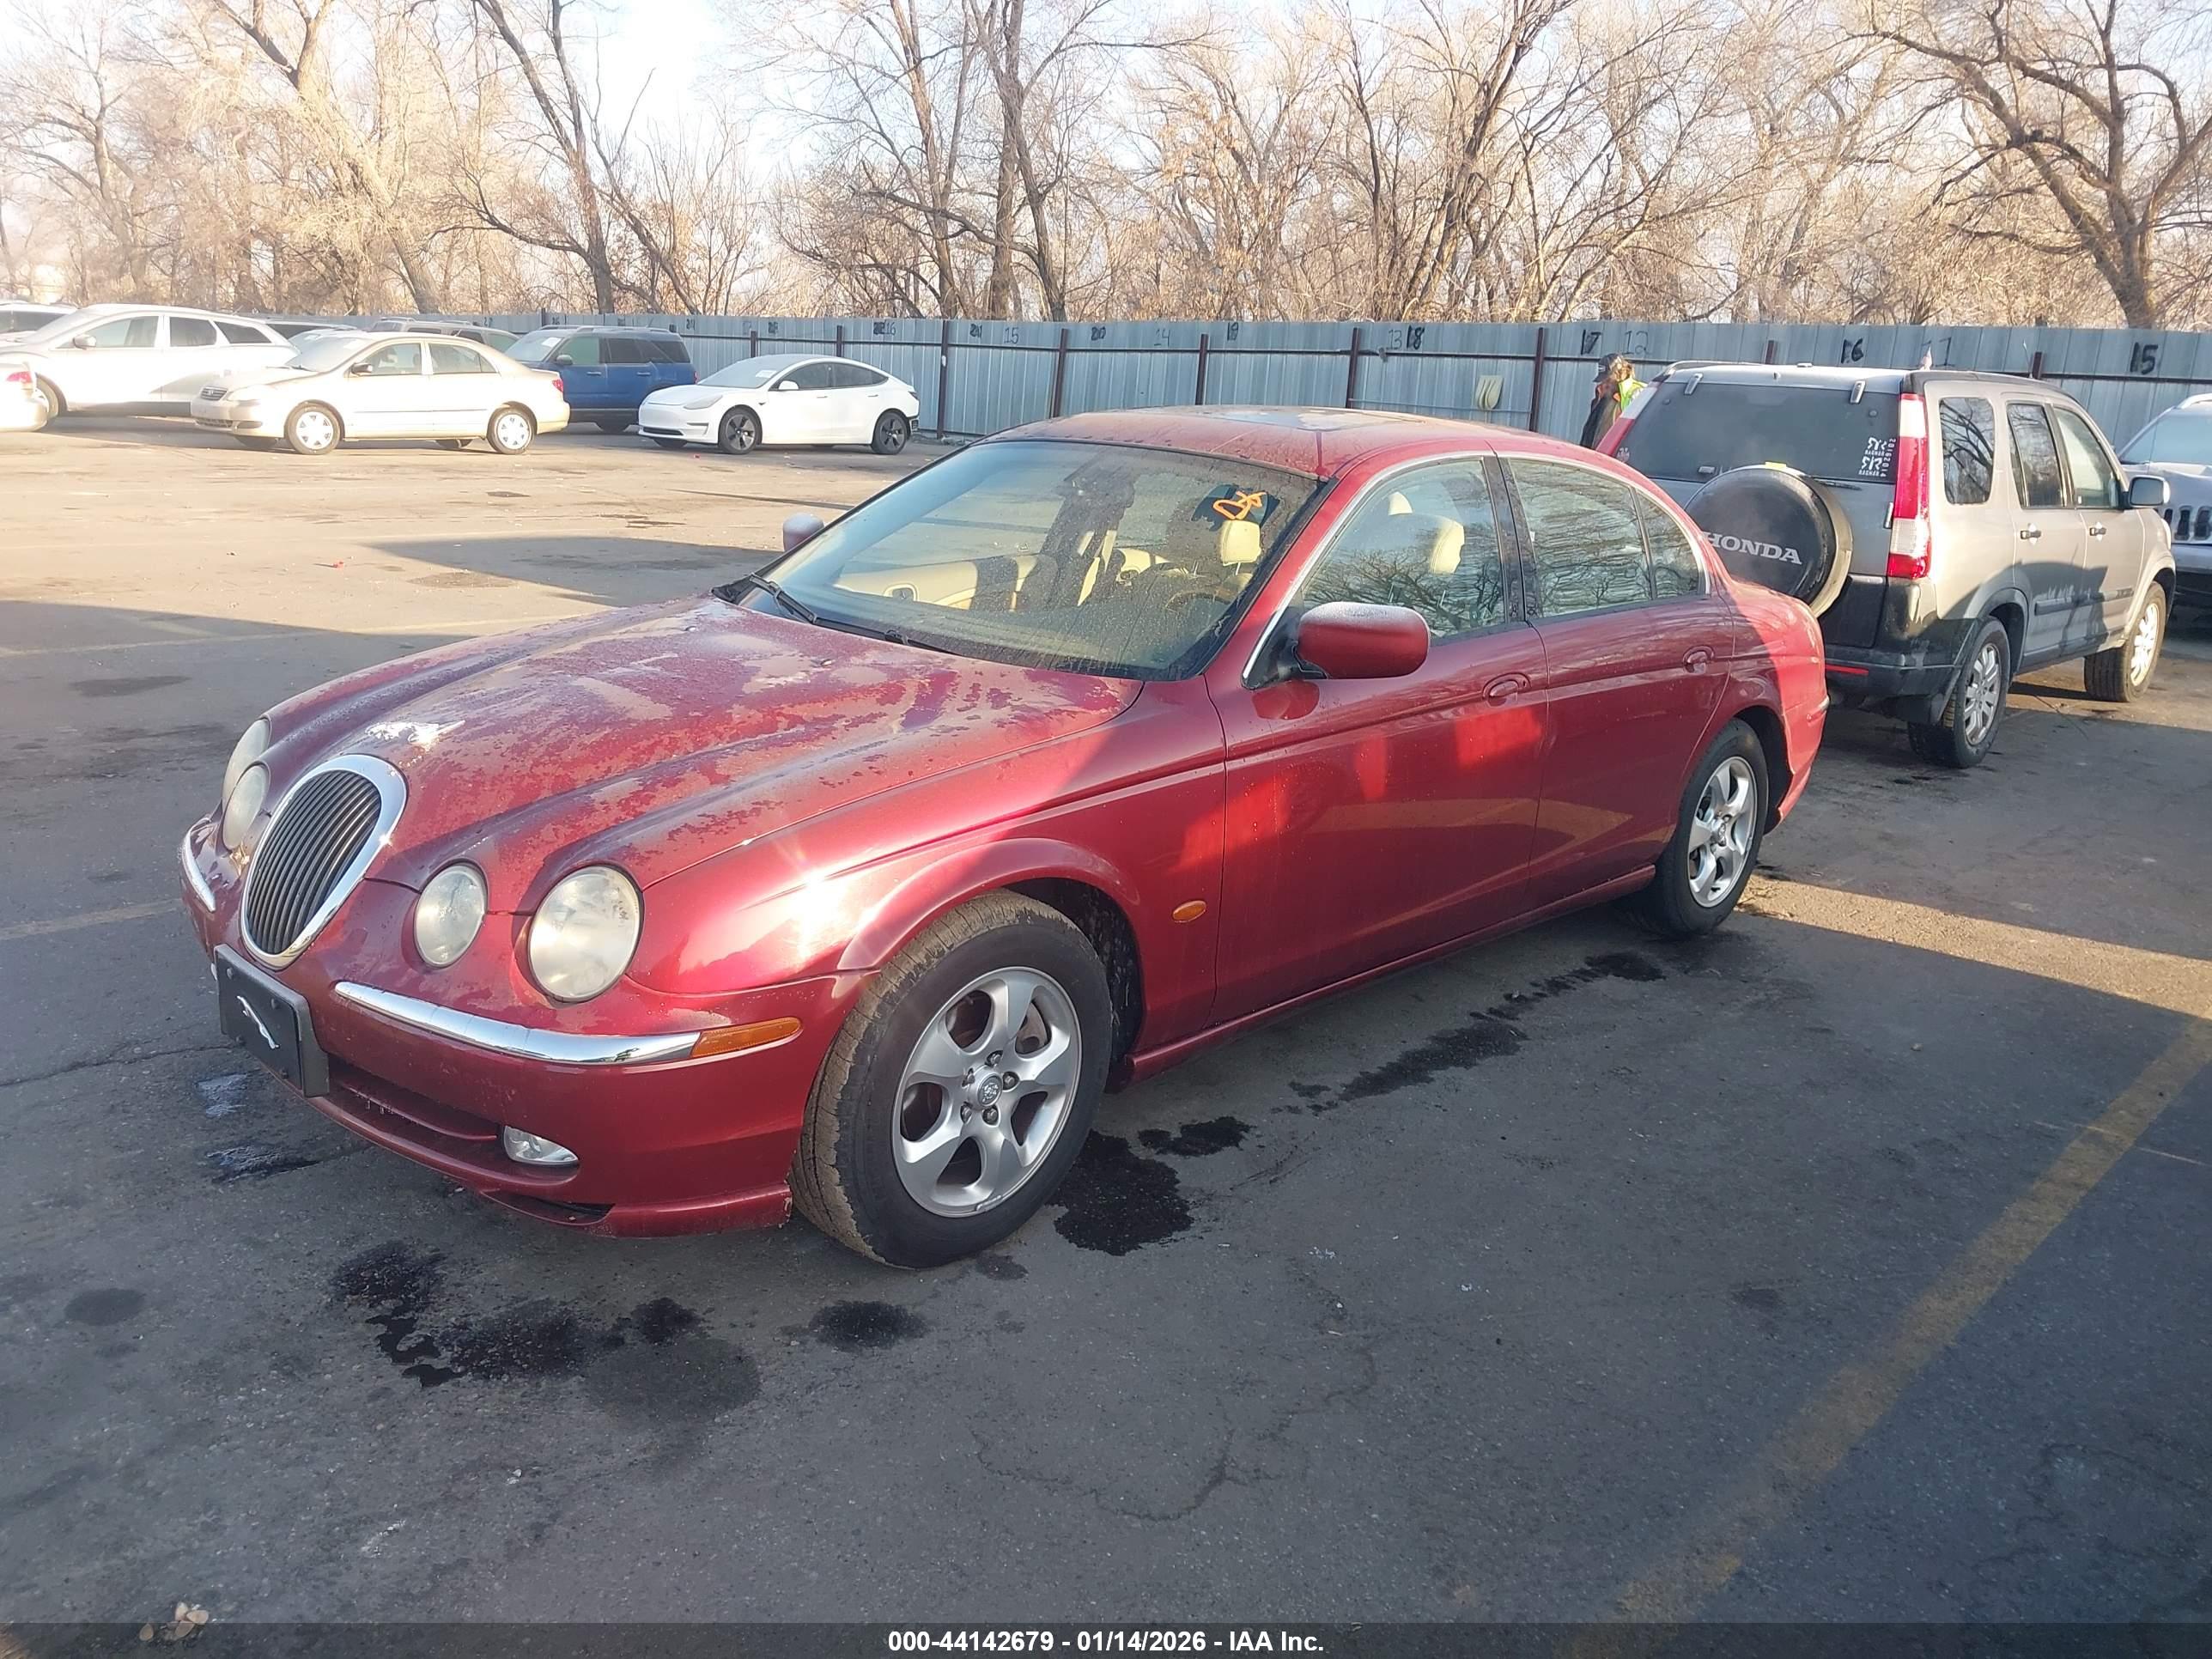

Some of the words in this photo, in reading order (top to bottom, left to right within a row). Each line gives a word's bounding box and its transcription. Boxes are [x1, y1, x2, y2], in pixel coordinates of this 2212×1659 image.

[1004, 326, 1019, 344] 15
[1386, 330, 1402, 350] 13
[1407, 325, 1425, 349] 18
[1581, 330, 1602, 355] 17
[1622, 331, 1650, 355] 12
[1840, 338, 1864, 363] 16
[2130, 342, 2159, 375] 15
[1703, 531, 1802, 566] HONDA
